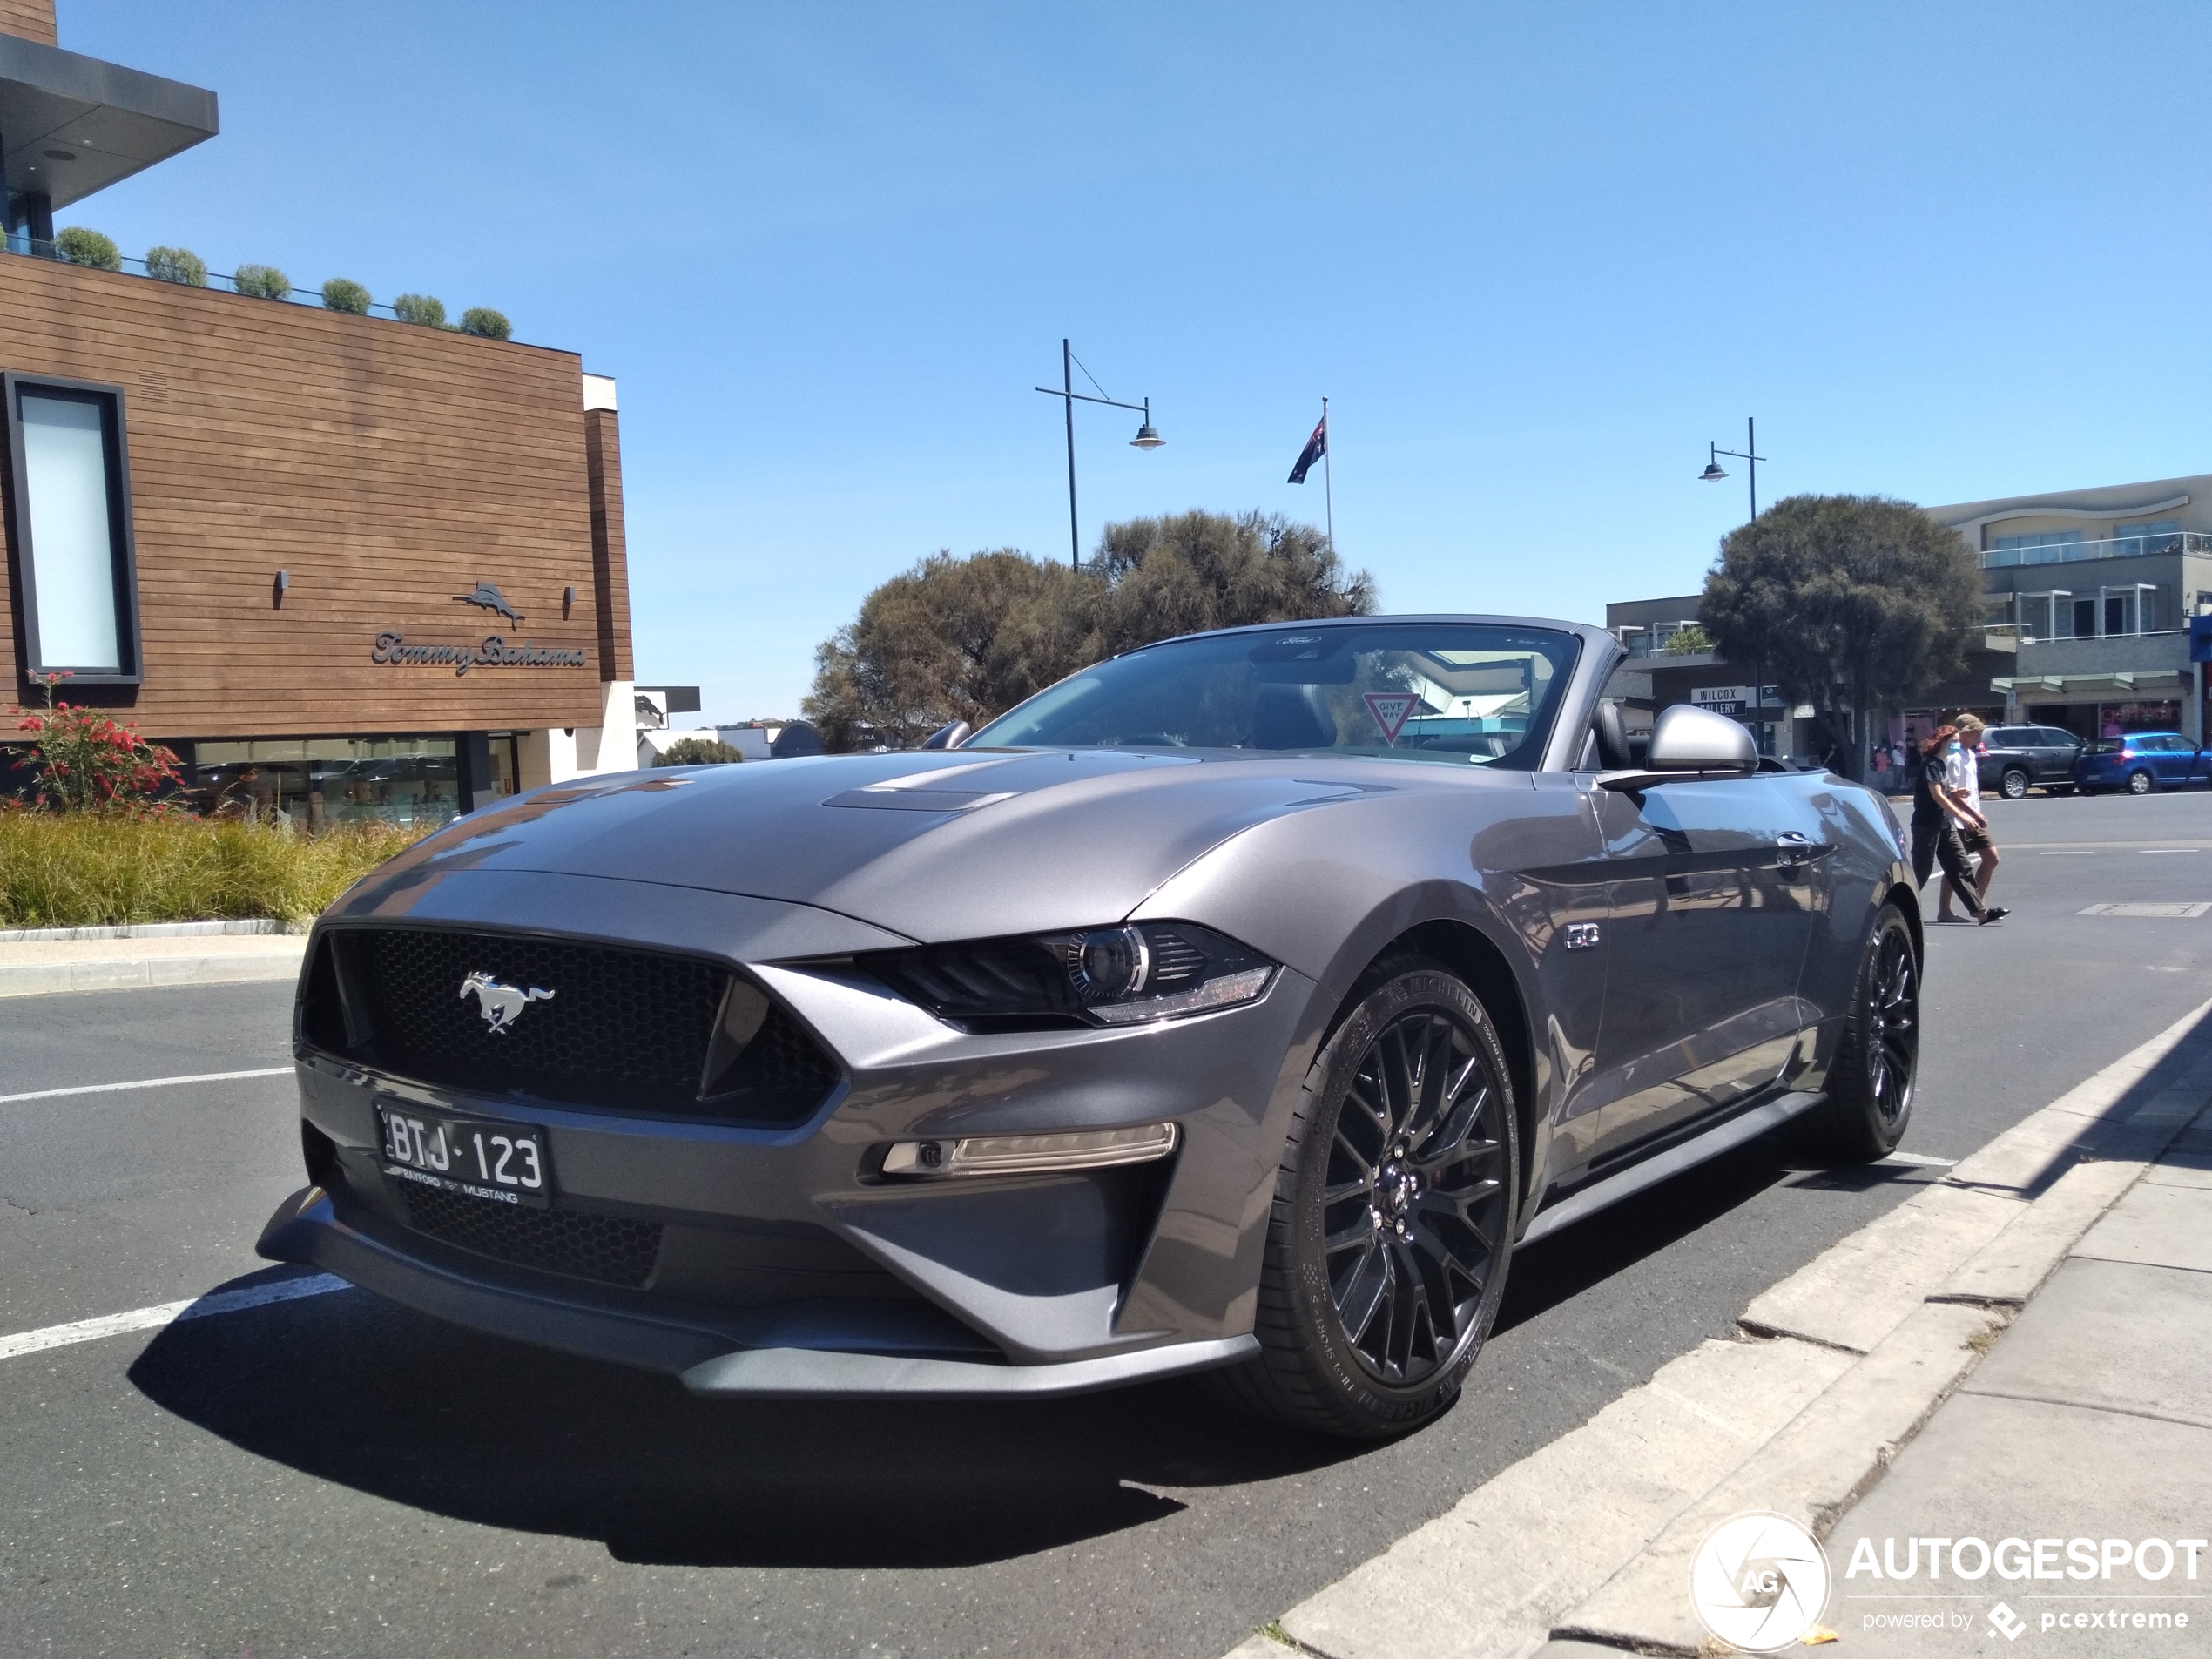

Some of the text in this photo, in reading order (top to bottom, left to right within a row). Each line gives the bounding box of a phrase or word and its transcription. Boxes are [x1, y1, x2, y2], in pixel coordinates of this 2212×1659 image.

[372, 631, 586, 677] Tommy Bahama
[1379, 702, 1404, 711] GIVE
[1700, 688, 1737, 701] WILCOX
[381, 1112, 395, 1157] VIC
[403, 1168, 518, 1204] BAYFORD MUSTANG
[1315, 1318, 1335, 1359] SPORT
